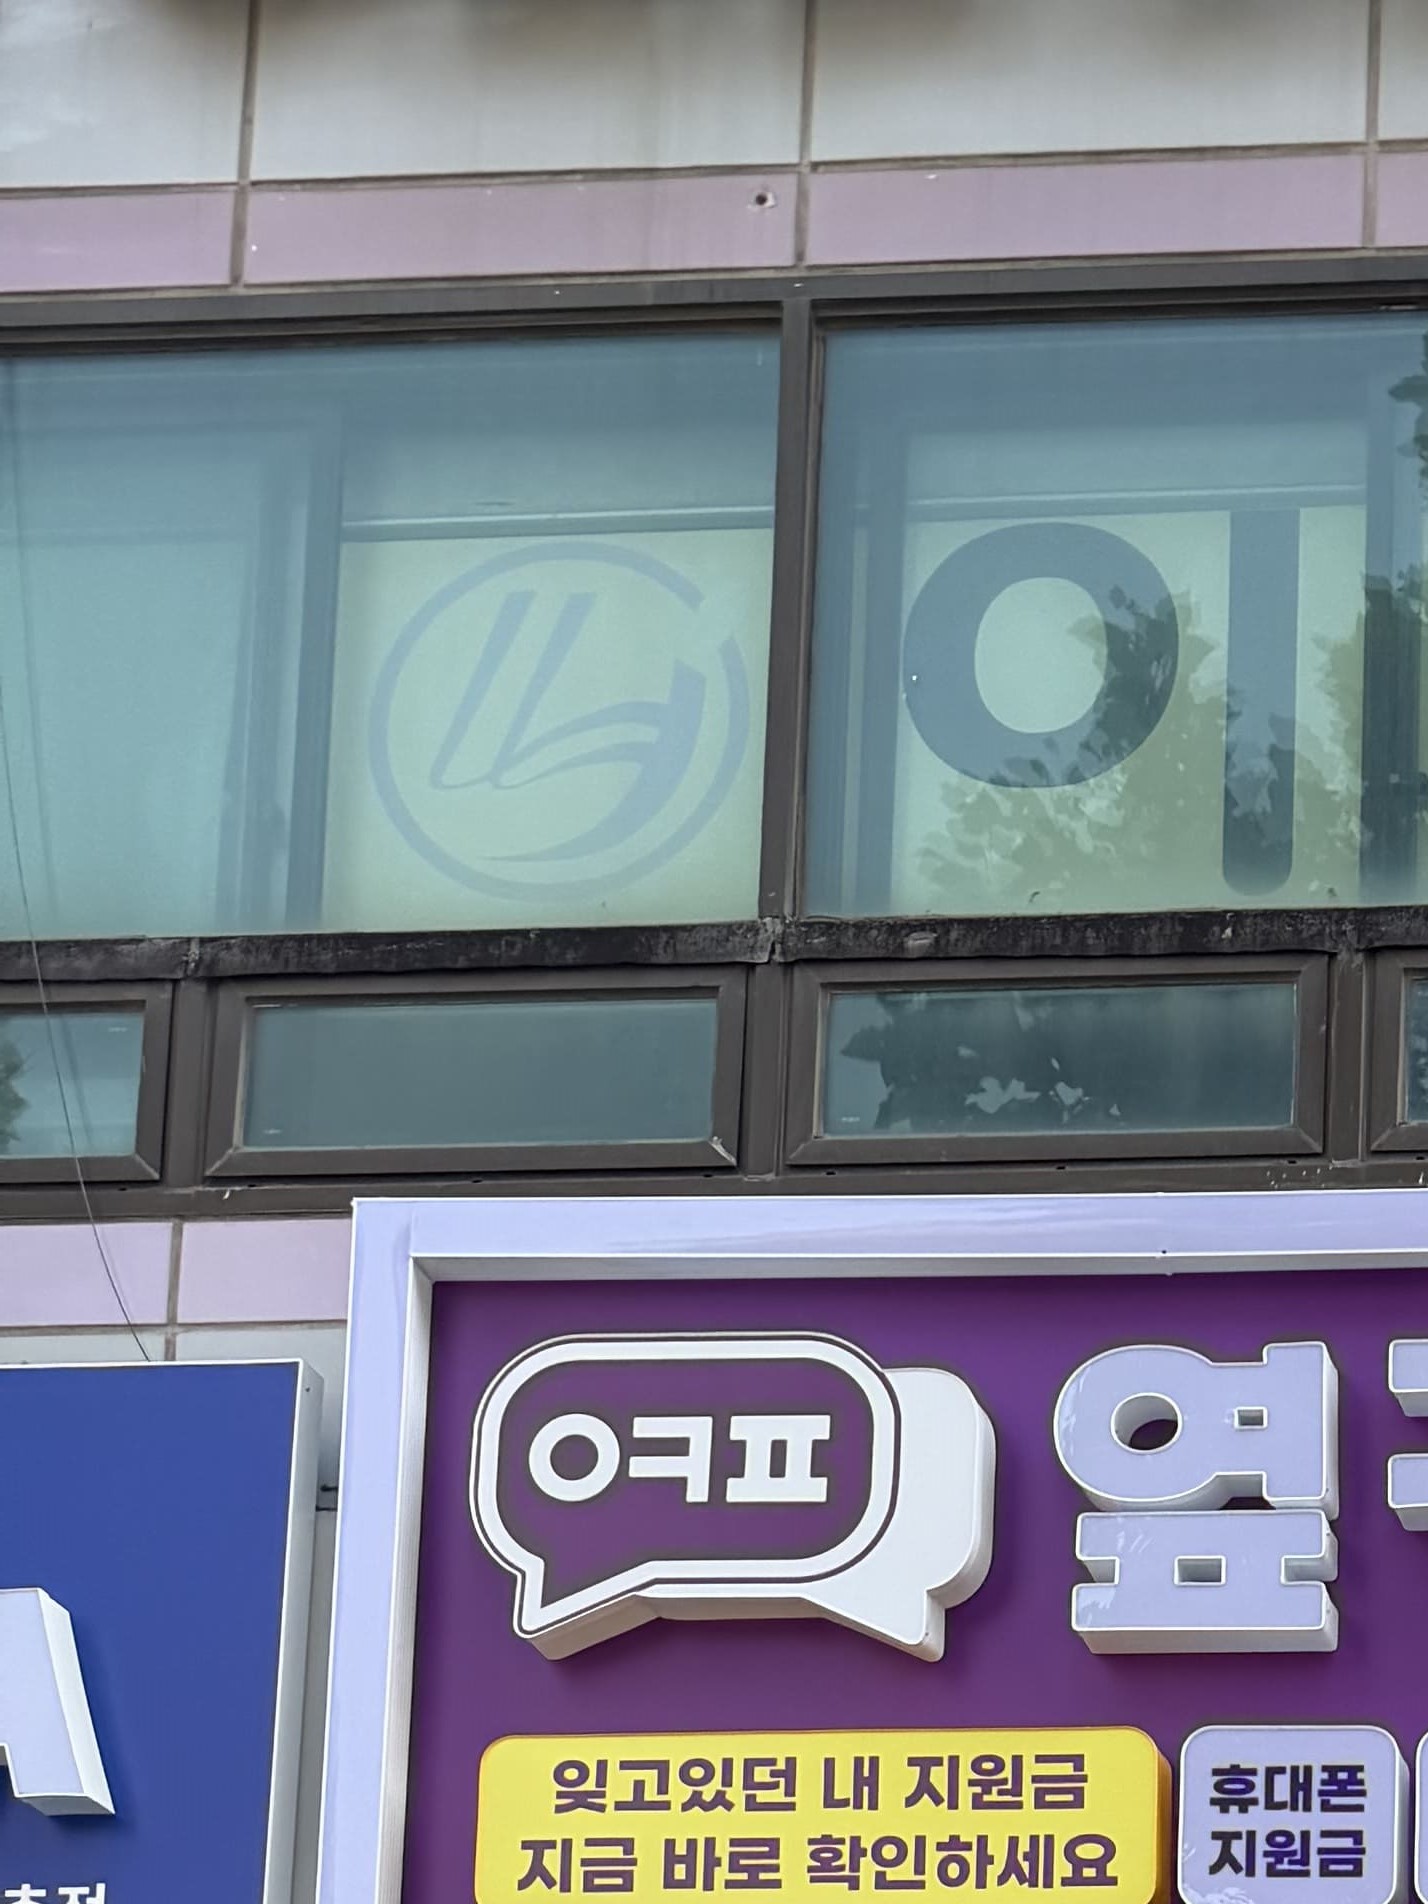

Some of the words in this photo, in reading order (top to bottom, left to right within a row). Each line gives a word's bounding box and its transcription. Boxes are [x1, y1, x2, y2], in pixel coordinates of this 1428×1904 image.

[551, 1755, 797, 1817] 잊고있던
[821, 1756, 880, 1812] 내
[904, 1754, 1089, 1810] 지원금
[1208, 1765, 1367, 1815] 휴대폰
[517, 1837, 637, 1894] 지금
[663, 1835, 784, 1891] 바로
[806, 1831, 1120, 1891] 확인하세요
[1208, 1831, 1367, 1879] 지원금
